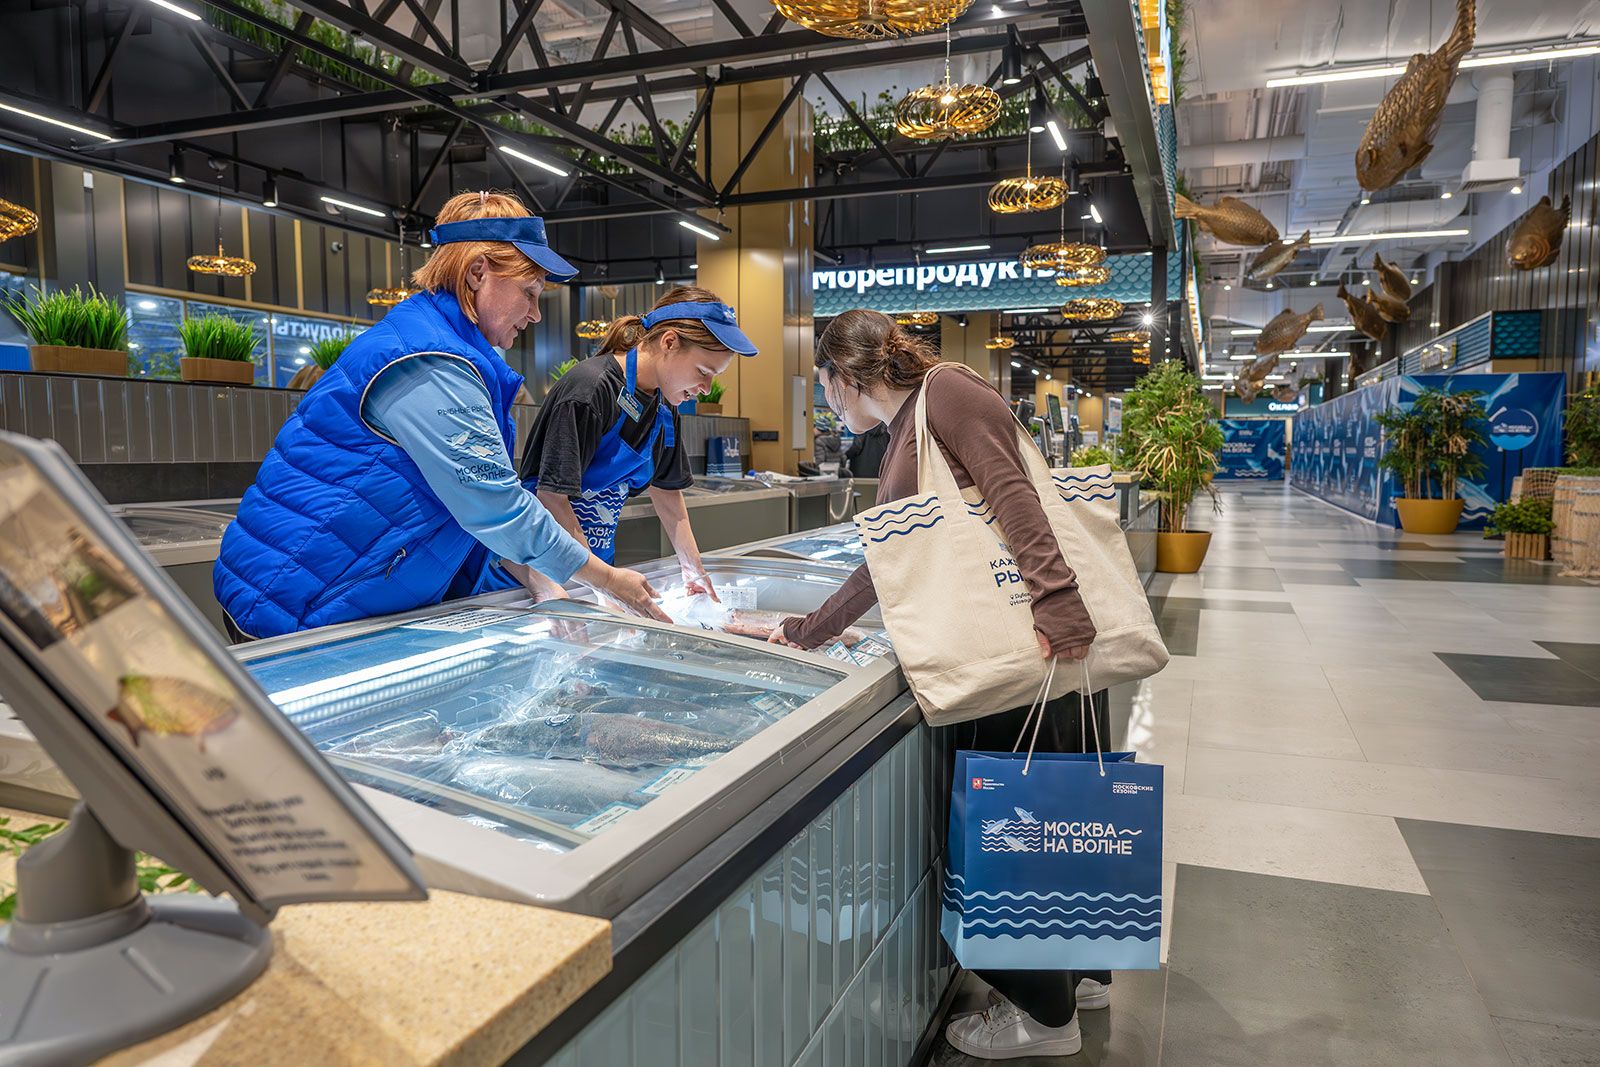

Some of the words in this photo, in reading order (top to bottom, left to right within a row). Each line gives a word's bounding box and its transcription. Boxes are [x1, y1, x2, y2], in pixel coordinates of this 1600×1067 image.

[455, 463, 498, 476] МОСКВА
[989, 557, 1018, 570] КАЖ
[994, 569, 1024, 588] РЫ
[1044, 821, 1117, 838] МОСКВА
[1044, 838, 1069, 853] НА
[1072, 838, 1132, 855] ВОЛНЕ
